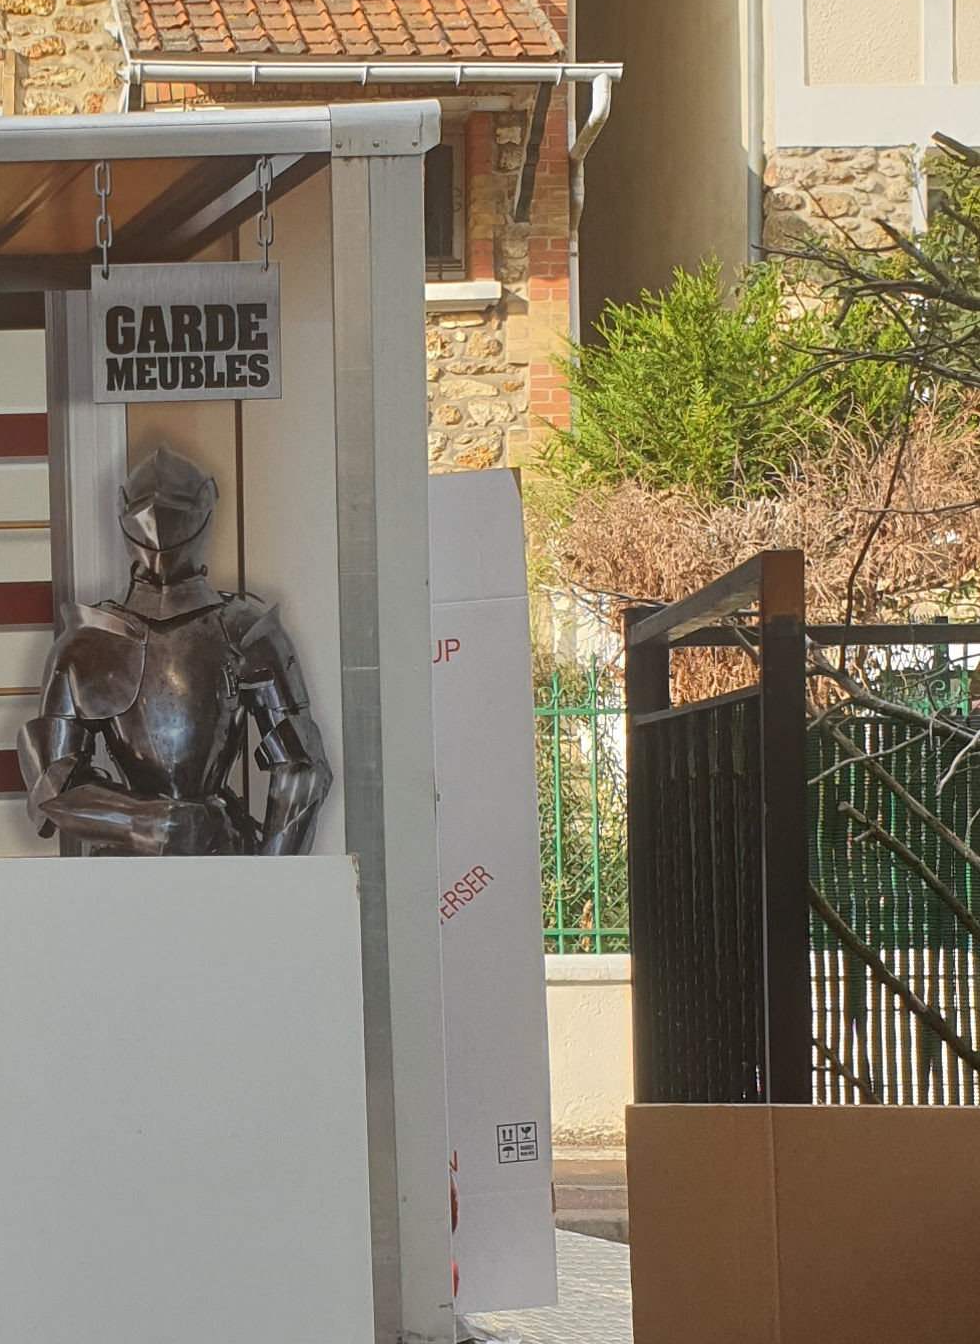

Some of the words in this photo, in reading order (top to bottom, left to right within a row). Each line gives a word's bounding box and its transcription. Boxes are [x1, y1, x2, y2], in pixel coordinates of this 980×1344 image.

[105, 303, 269, 355] GARDE
[106, 353, 270, 391] MEUBLES
[440, 865, 495, 926] ERSER
